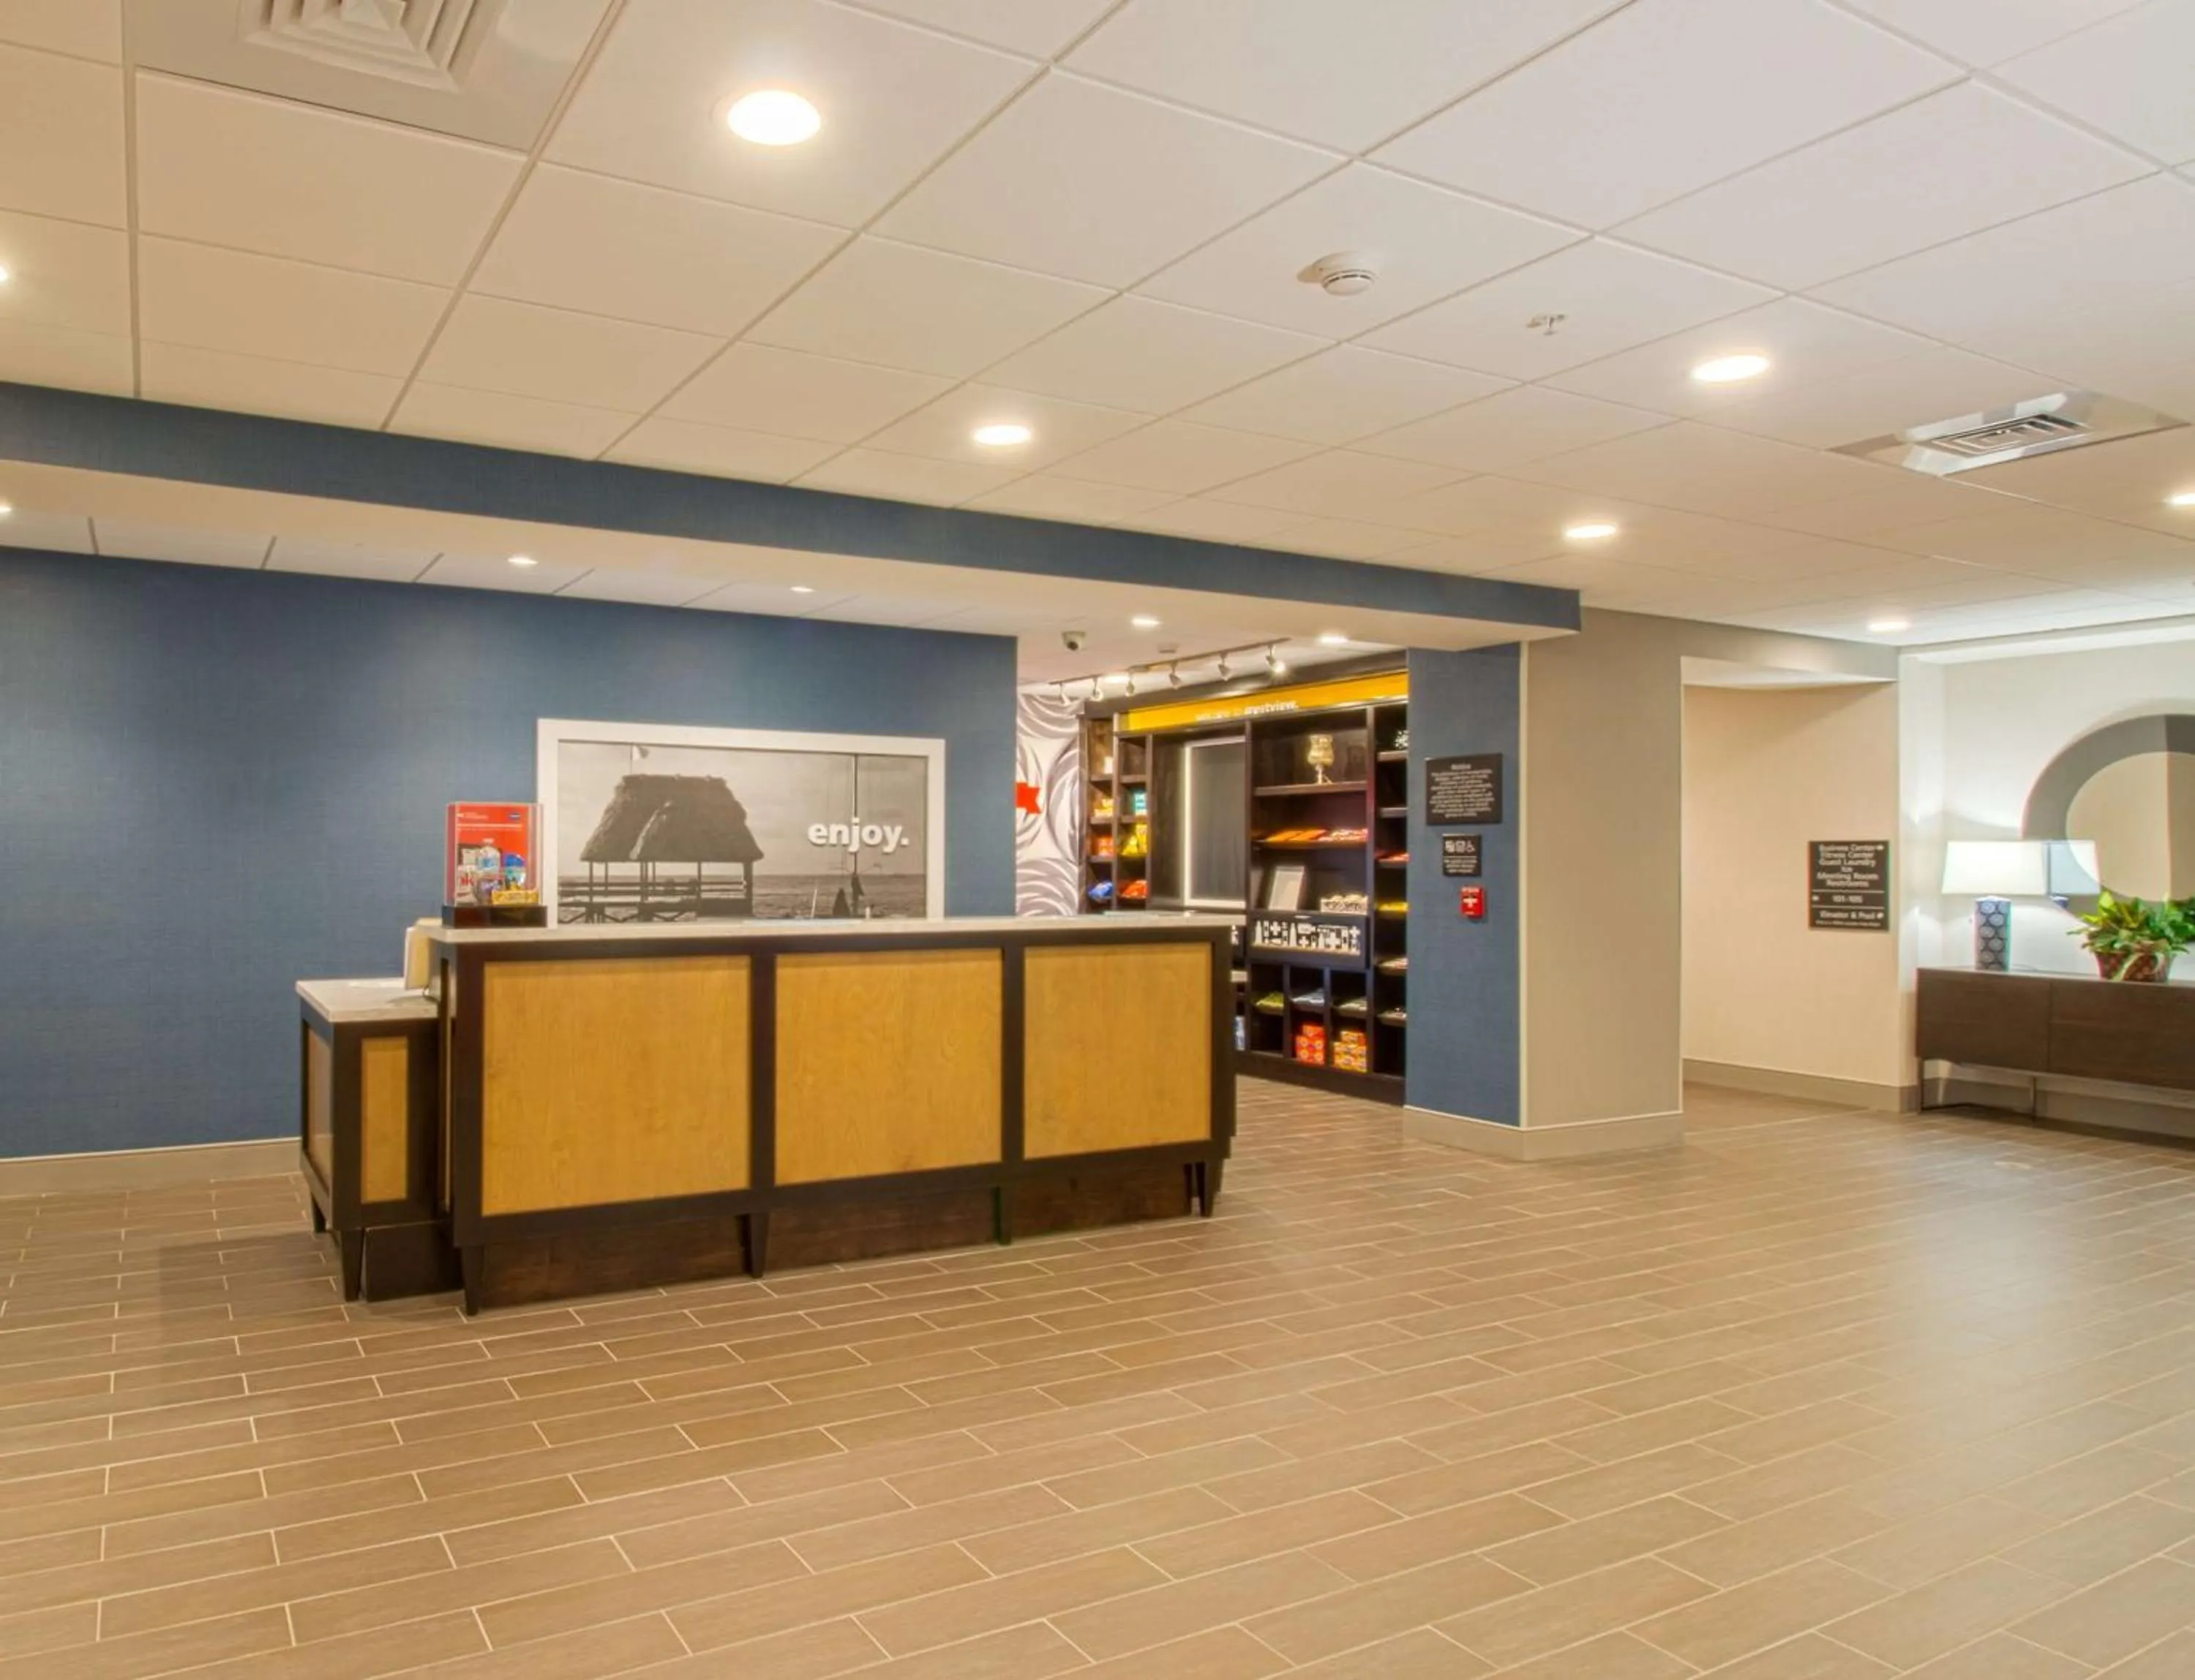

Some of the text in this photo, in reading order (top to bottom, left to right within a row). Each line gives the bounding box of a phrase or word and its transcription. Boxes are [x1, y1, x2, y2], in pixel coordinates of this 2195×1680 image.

[808, 817, 909, 853] enjoy.
[1850, 844, 1875, 852] Center
[1843, 858, 1877, 868] Laundry
[1817, 871, 1880, 881] Meeting Room
